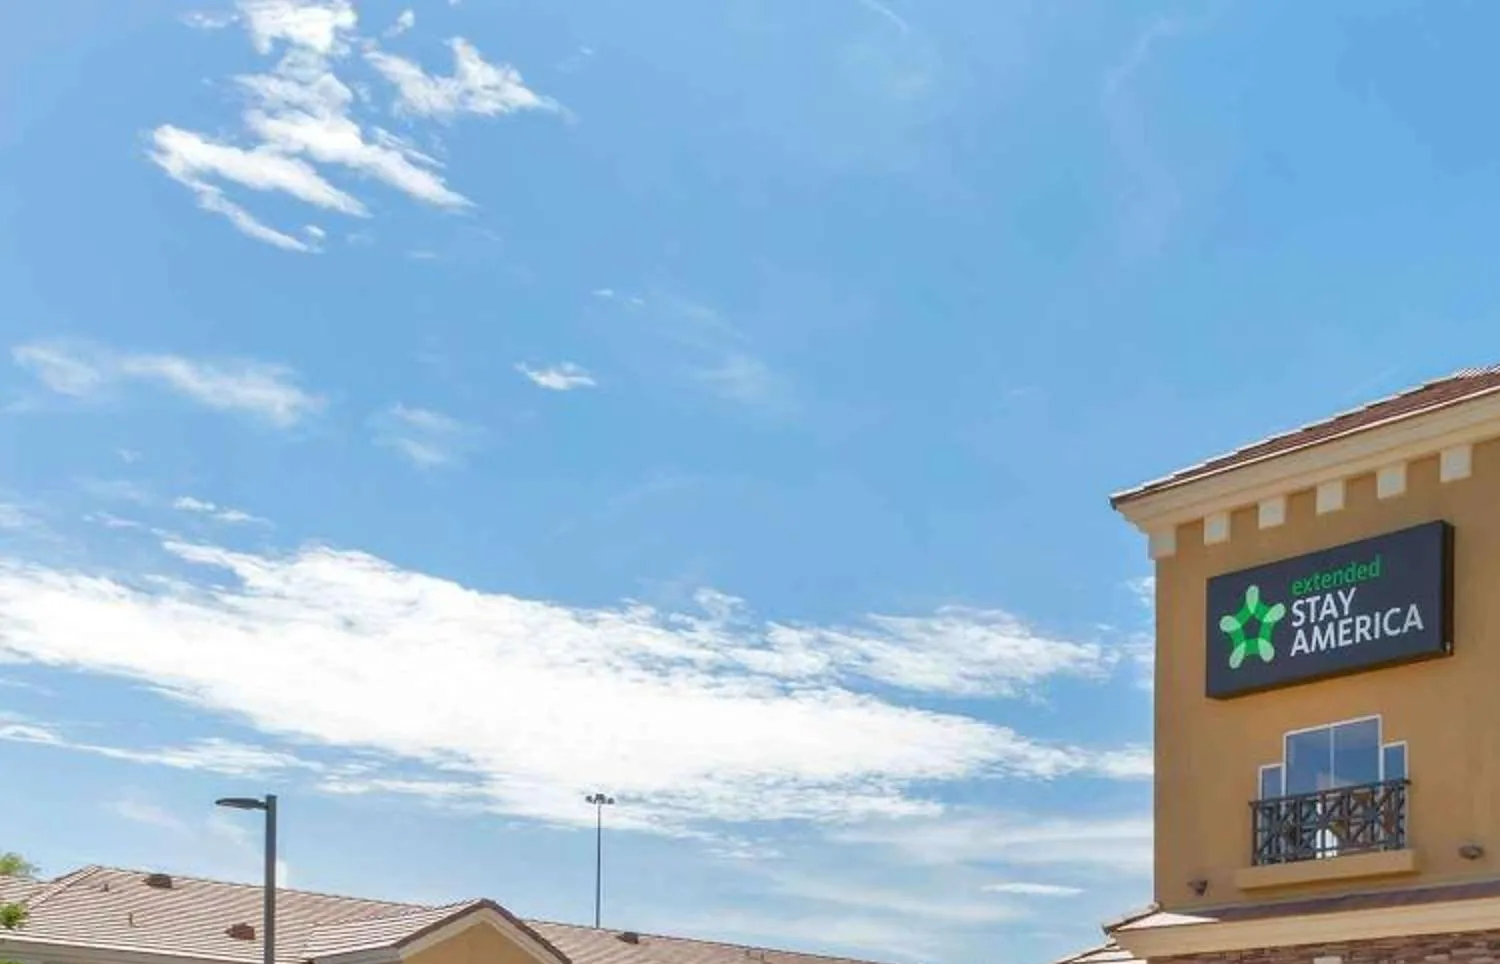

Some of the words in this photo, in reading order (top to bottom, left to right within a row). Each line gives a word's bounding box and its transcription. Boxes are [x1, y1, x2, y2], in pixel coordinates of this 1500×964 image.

[1292, 554, 1381, 595] extended
[1291, 587, 1357, 627] STAY
[1290, 604, 1424, 657] AMERICA
